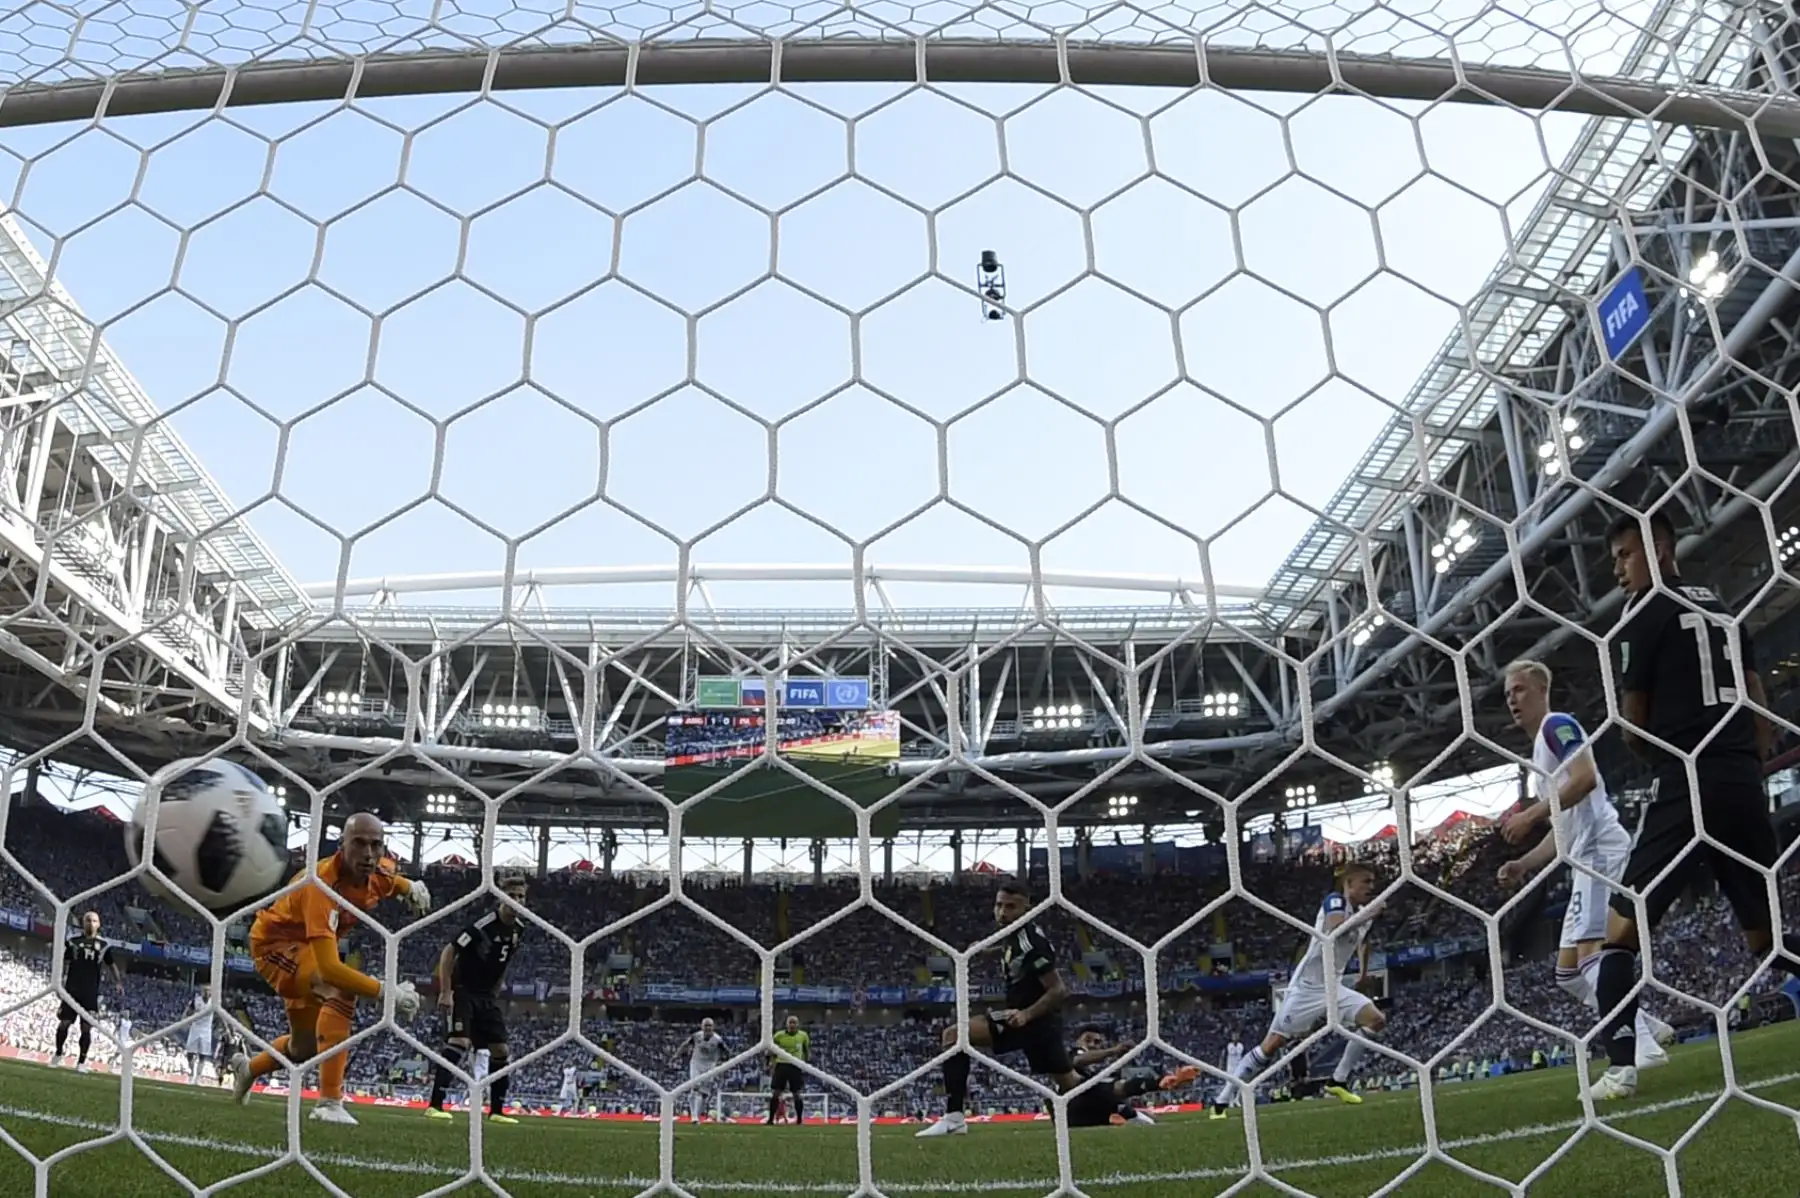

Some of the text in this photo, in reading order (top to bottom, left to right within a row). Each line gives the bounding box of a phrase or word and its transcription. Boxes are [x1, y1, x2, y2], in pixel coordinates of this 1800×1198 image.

[1606, 290, 1640, 339] FIFA
[789, 688, 818, 699] FIFA
[499, 944, 509, 962] 5
